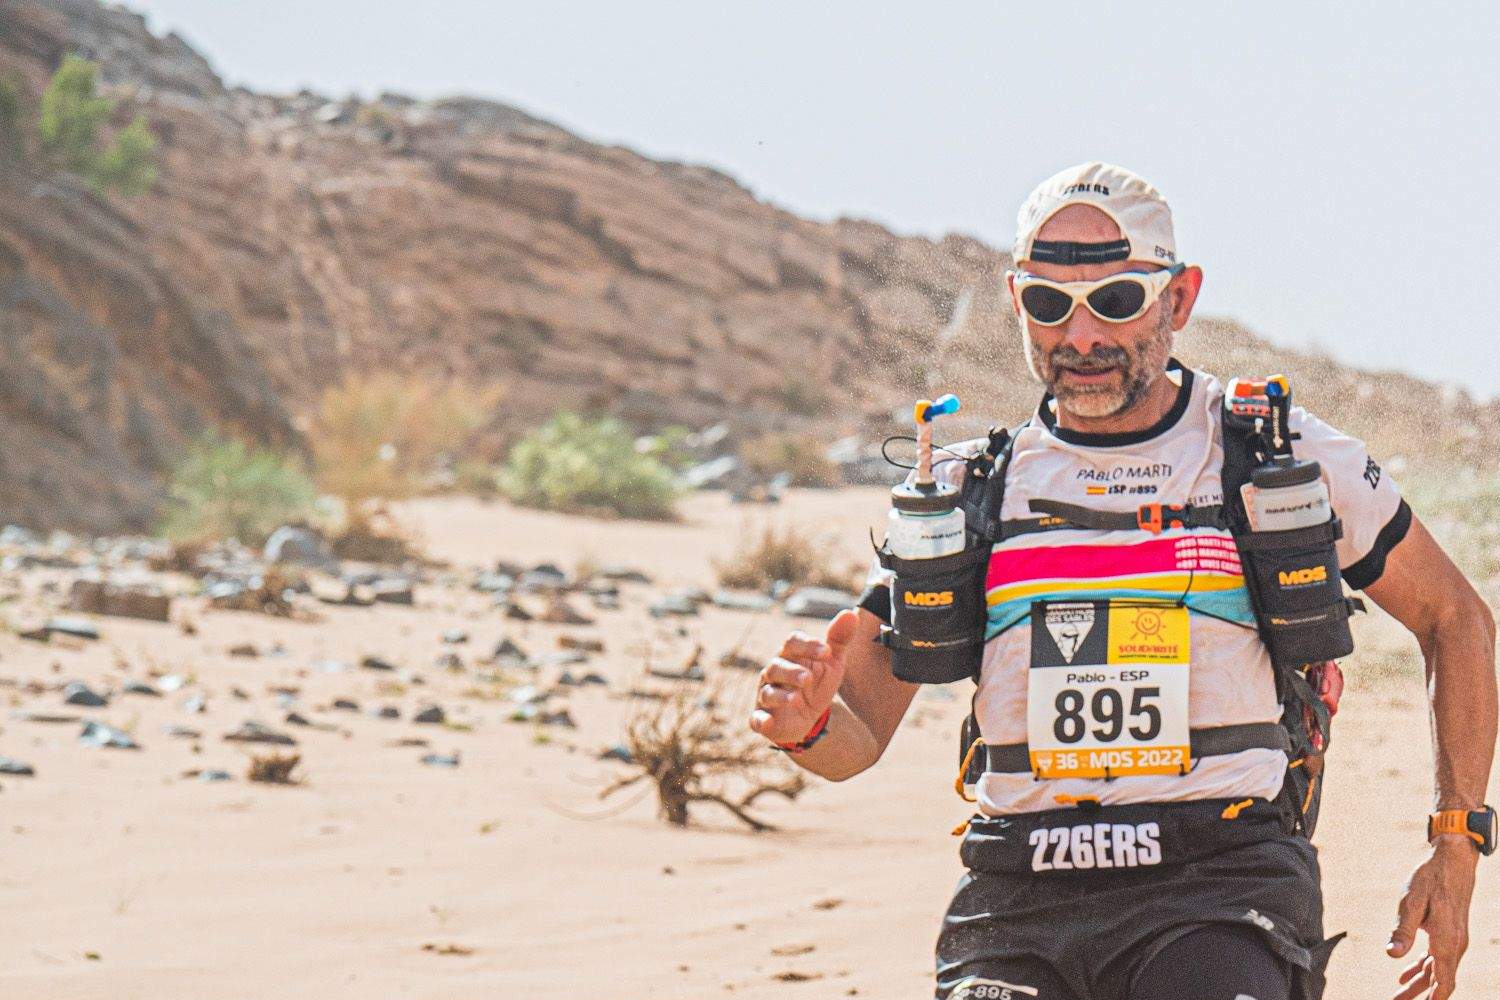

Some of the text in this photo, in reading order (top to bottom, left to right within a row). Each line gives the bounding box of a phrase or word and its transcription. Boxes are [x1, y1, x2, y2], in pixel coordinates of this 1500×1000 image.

[1076, 463, 1172, 481] PABLO MARTI
[1278, 565, 1328, 585] MDS
[904, 590, 954, 606] MDS
[1066, 672, 1106, 684] Pablo
[1120, 670, 1149, 682] ESP
[1053, 686, 1162, 744] 895
[1055, 752, 1079, 770] 36
[1089, 750, 1134, 769] MDS
[1137, 749, 1184, 768] 2022
[1028, 822, 1162, 872] 226ERS
